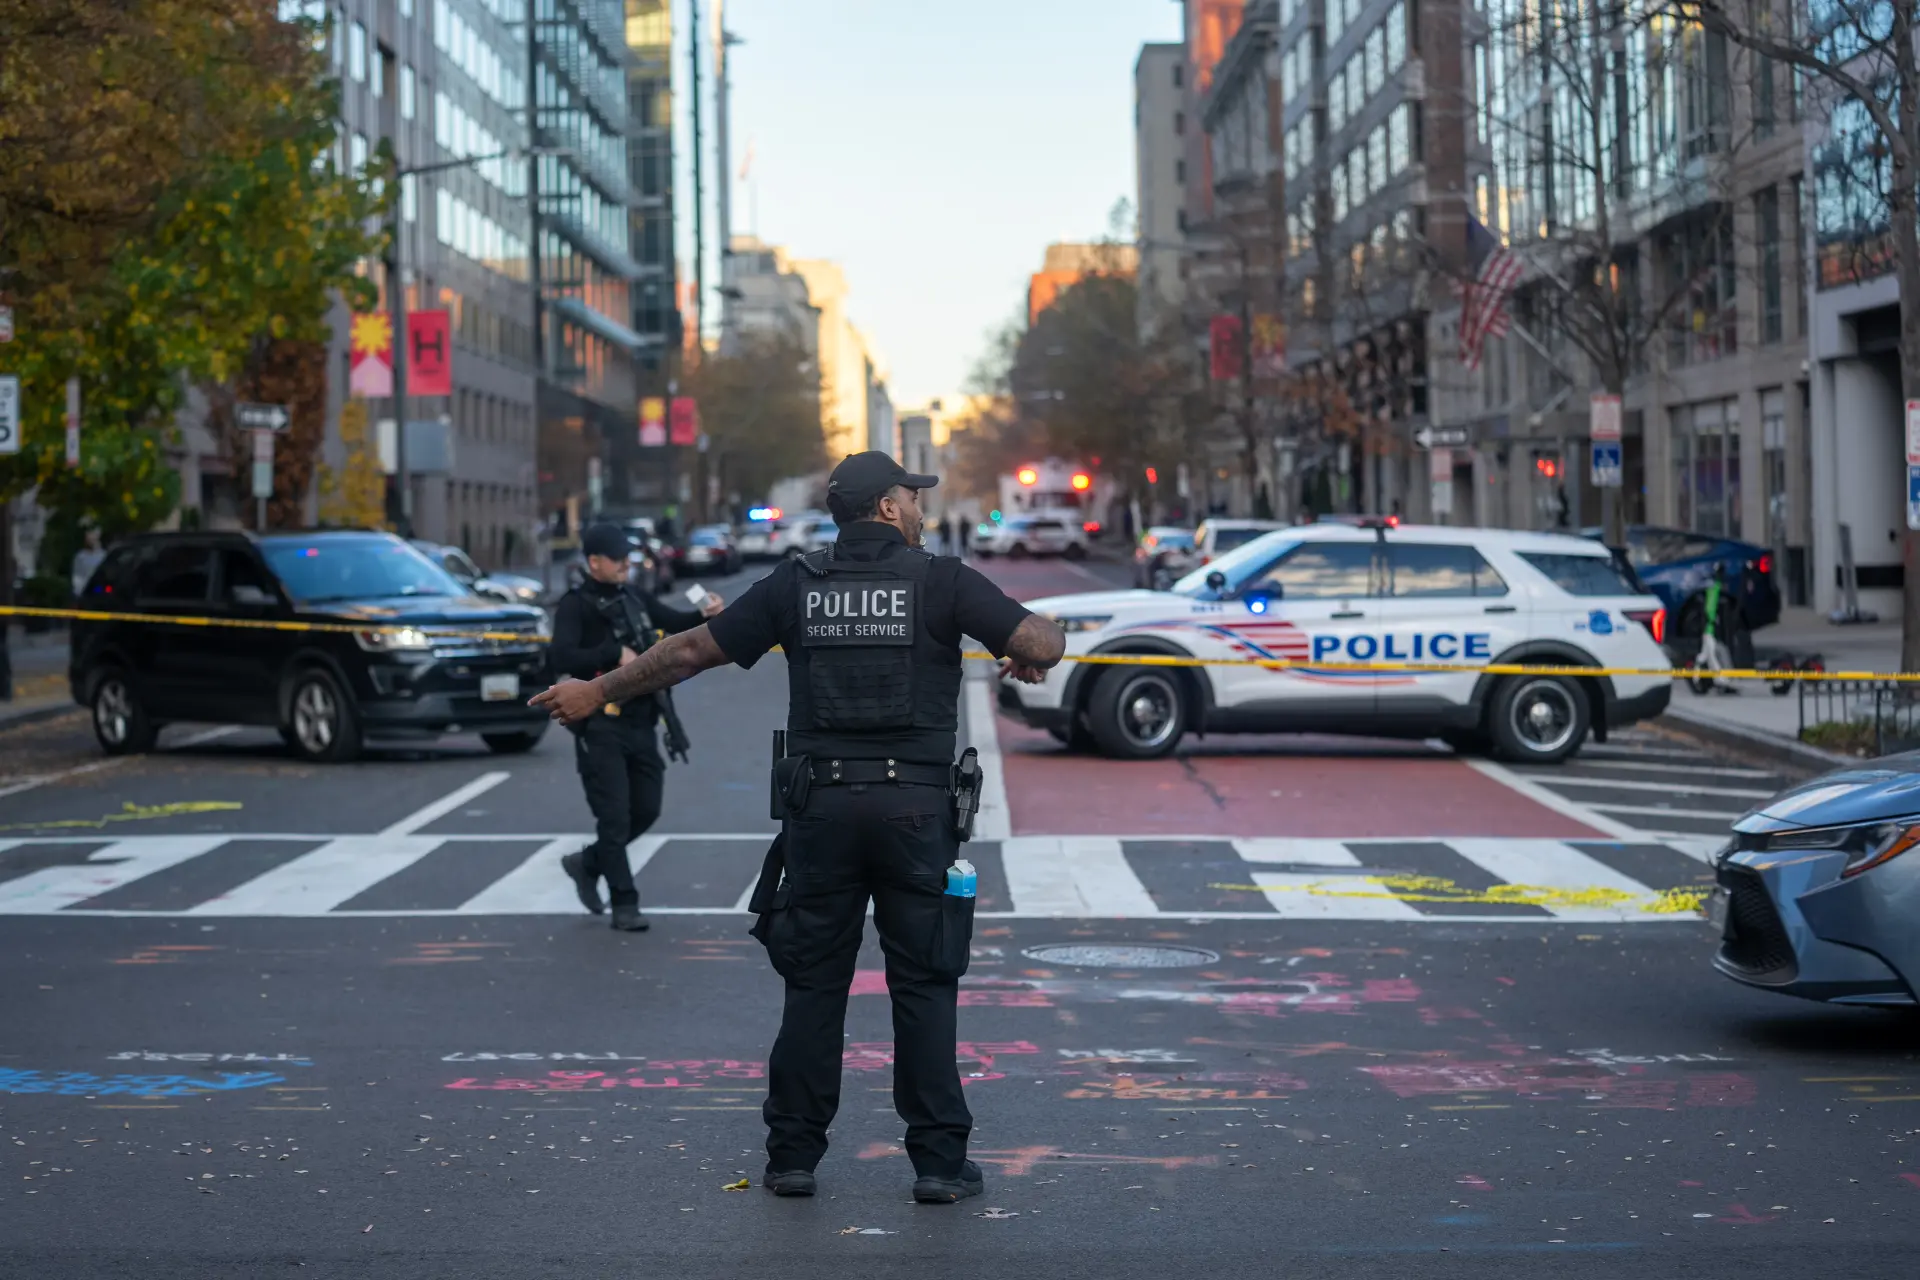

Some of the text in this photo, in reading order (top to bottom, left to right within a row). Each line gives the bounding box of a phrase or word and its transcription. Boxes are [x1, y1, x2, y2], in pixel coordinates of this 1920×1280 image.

[413, 329, 443, 364] H
[806, 589, 906, 619] POLICE
[807, 624, 906, 637] SECRET SERVICE
[1313, 632, 1491, 662] POLICE
